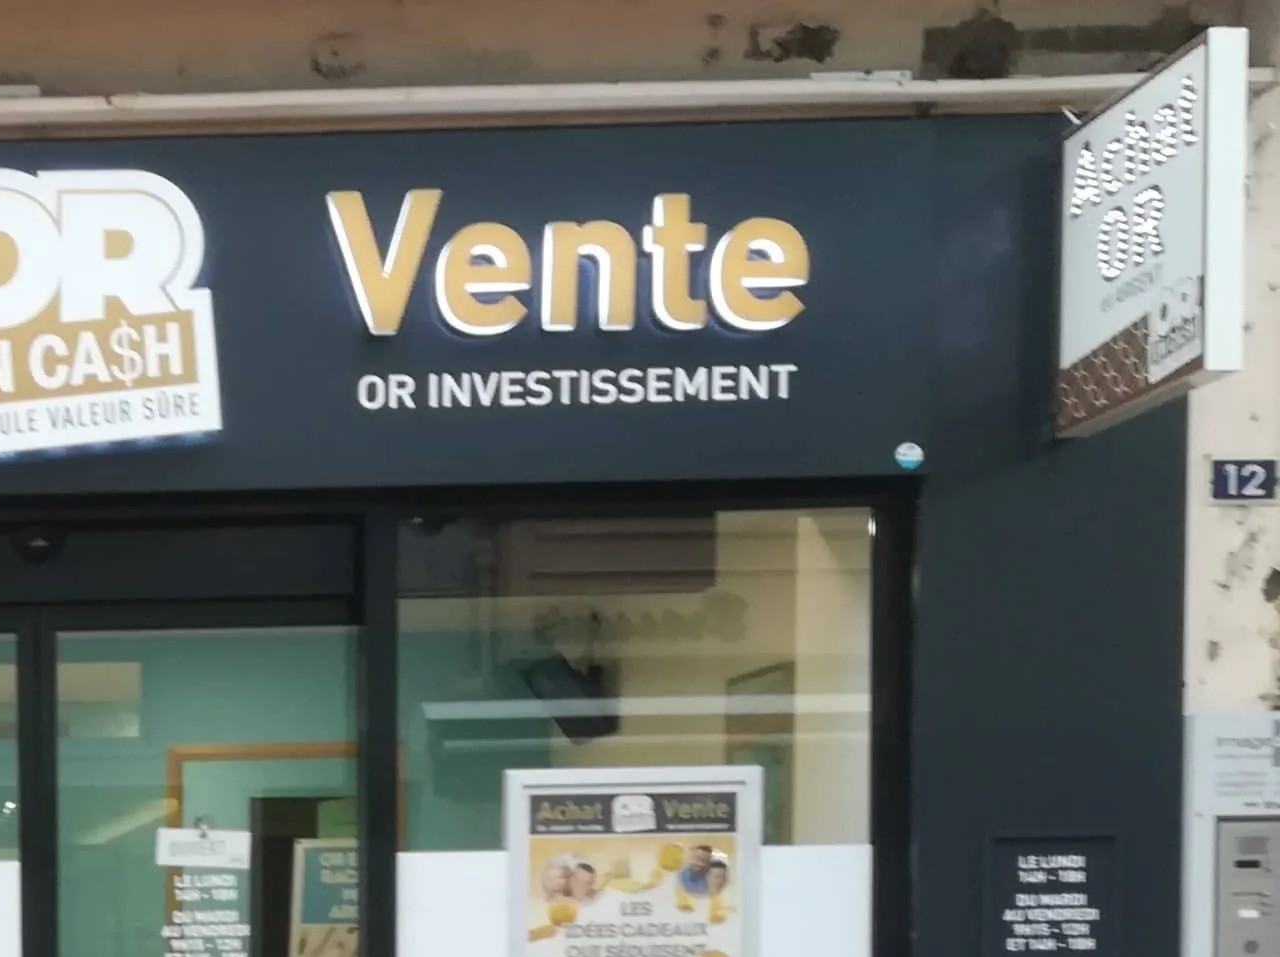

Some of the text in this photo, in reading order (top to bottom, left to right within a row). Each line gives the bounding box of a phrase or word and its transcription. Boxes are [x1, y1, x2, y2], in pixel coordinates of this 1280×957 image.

[1070, 75, 1199, 218] Achat
[1097, 184, 1165, 281] OR
[326, 188, 811, 336] Vente
[47, 400, 133, 429] VALEUR
[143, 390, 201, 421] SÛRE
[357, 364, 798, 410] OR INVESTISSEMENT
[1222, 463, 1267, 497] 12
[661, 798, 731, 820] Vente
